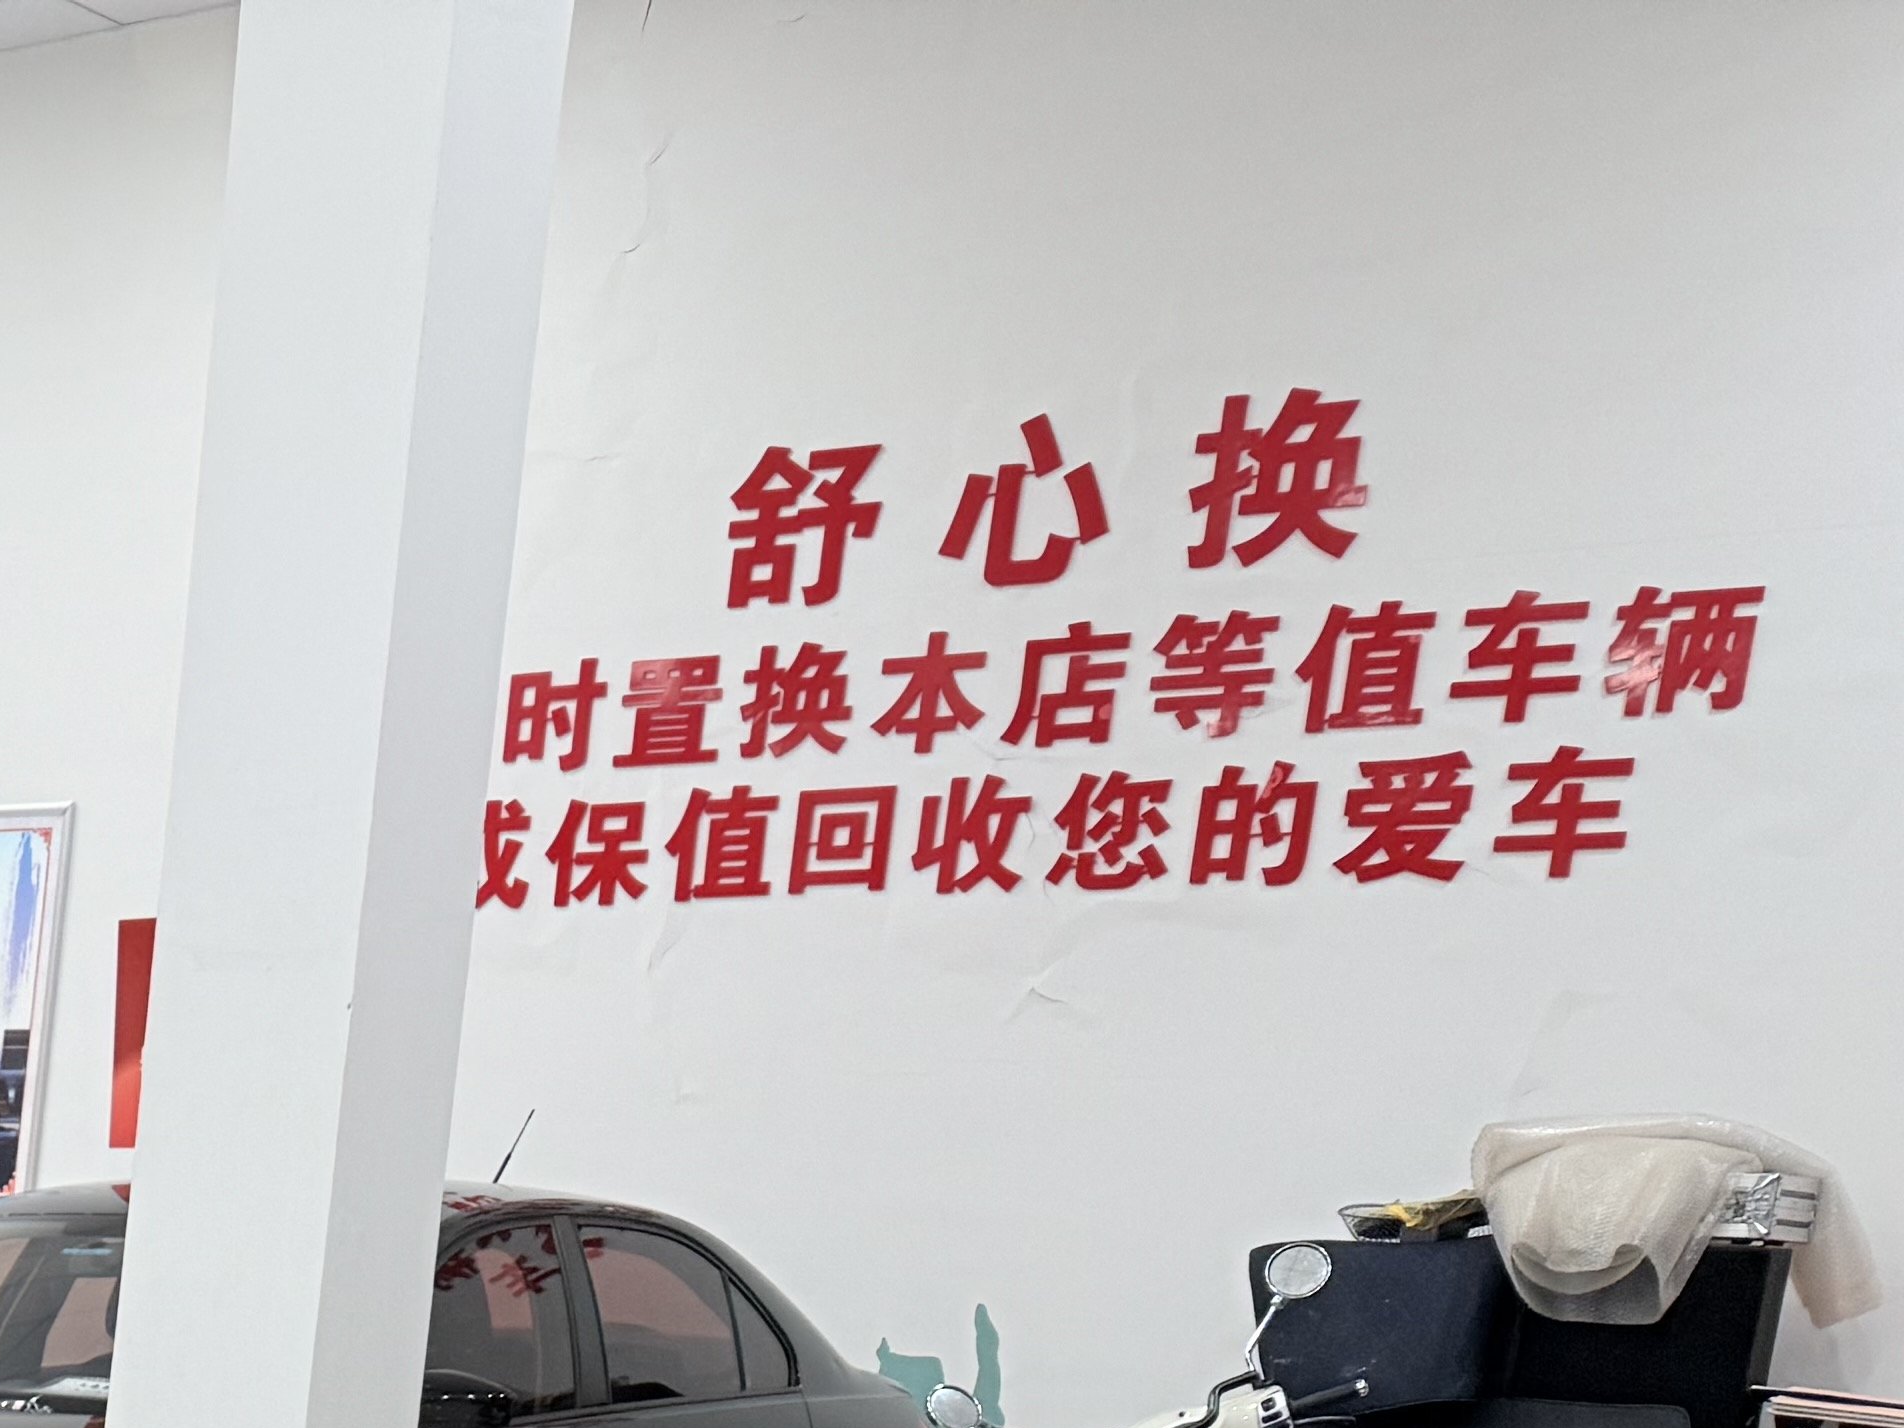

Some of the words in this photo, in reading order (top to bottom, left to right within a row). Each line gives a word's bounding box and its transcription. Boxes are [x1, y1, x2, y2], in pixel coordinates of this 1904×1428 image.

[727, 388, 1367, 609] 舒心换
[502, 586, 1766, 773] 时置换本店等值车辆
[476, 745, 1635, 910] 或保值回收您的爱车
